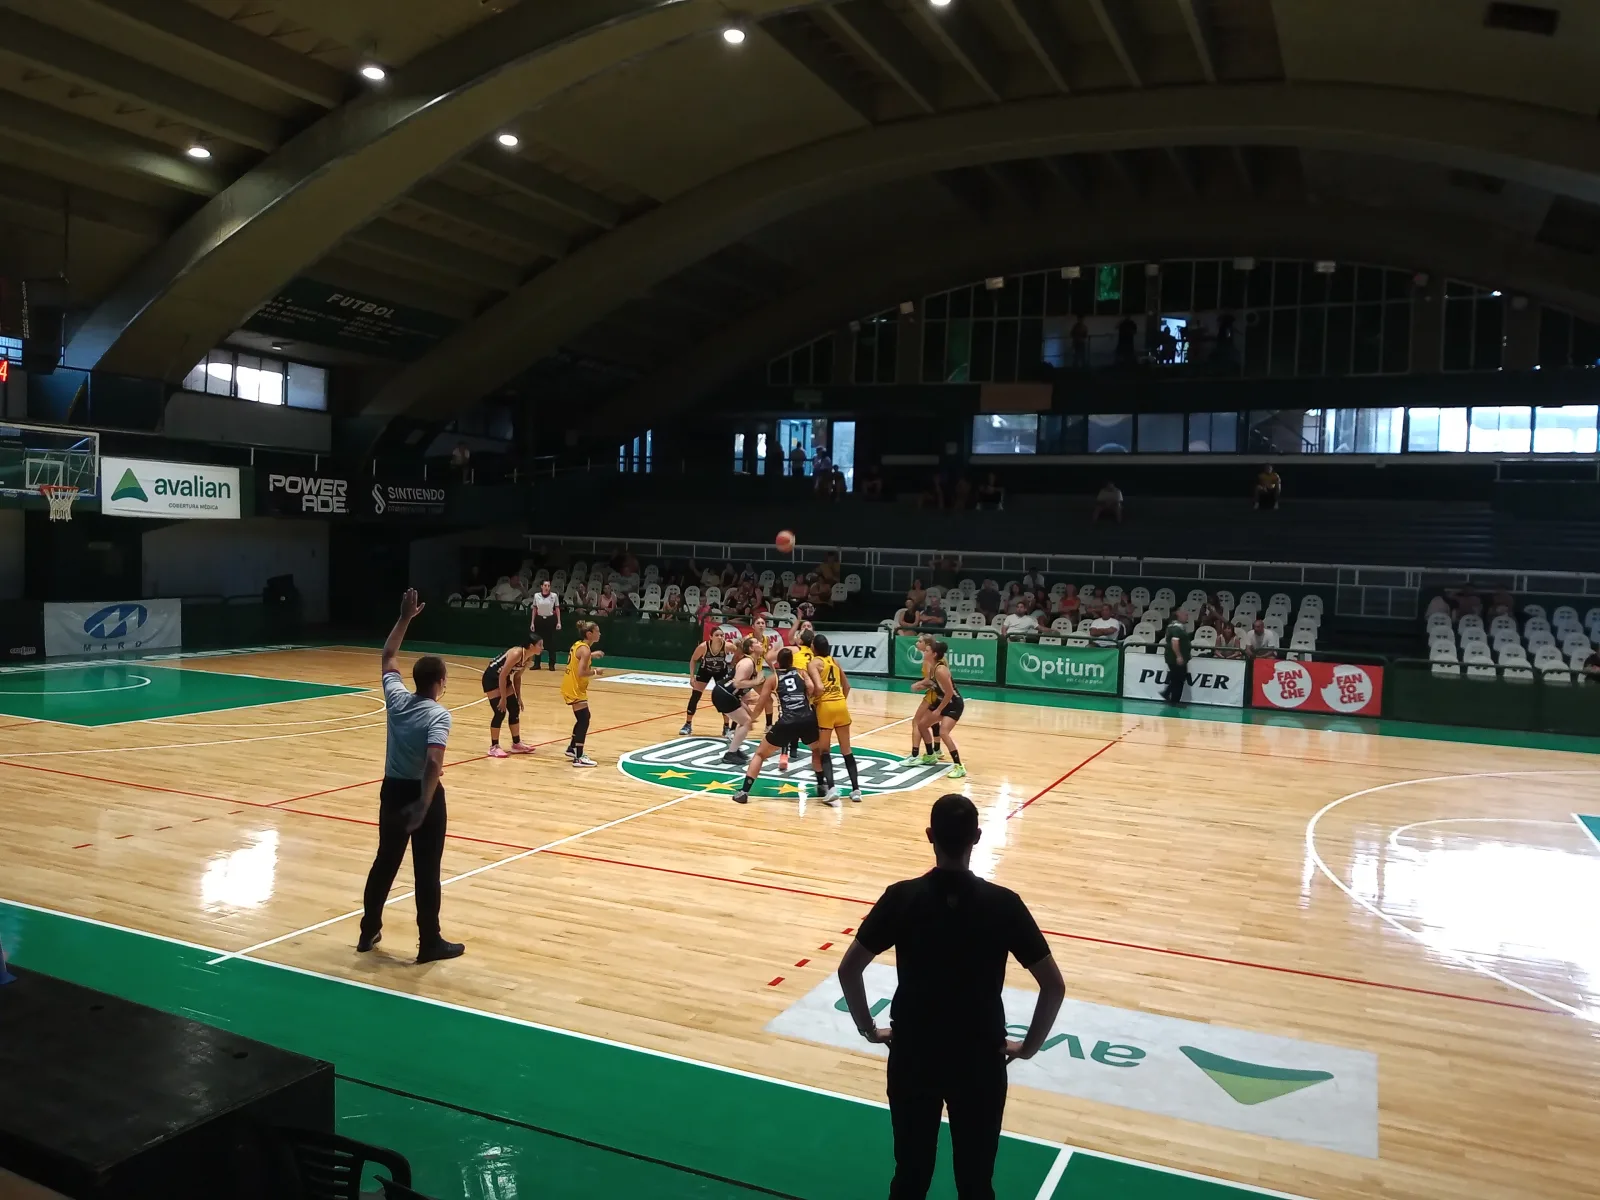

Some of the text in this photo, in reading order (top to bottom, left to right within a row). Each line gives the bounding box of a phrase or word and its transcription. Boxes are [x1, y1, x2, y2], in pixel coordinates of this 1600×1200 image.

[154, 475, 231, 499] avalian
[268, 473, 349, 497] POWER
[387, 486, 446, 501] SINTIENDO
[906, 644, 985, 668] Oium
[1019, 652, 1105, 680] Optium
[827, 665, 837, 685] 4
[1138, 668, 1232, 690] PUVER
[1277, 669, 1304, 682] FAN
[1336, 673, 1363, 686] FAN
[784, 677, 798, 692] 9
[1280, 680, 1297, 690] TO
[1338, 685, 1356, 695] TO
[1280, 687, 1306, 700] CHE
[1339, 692, 1366, 705] CHE
